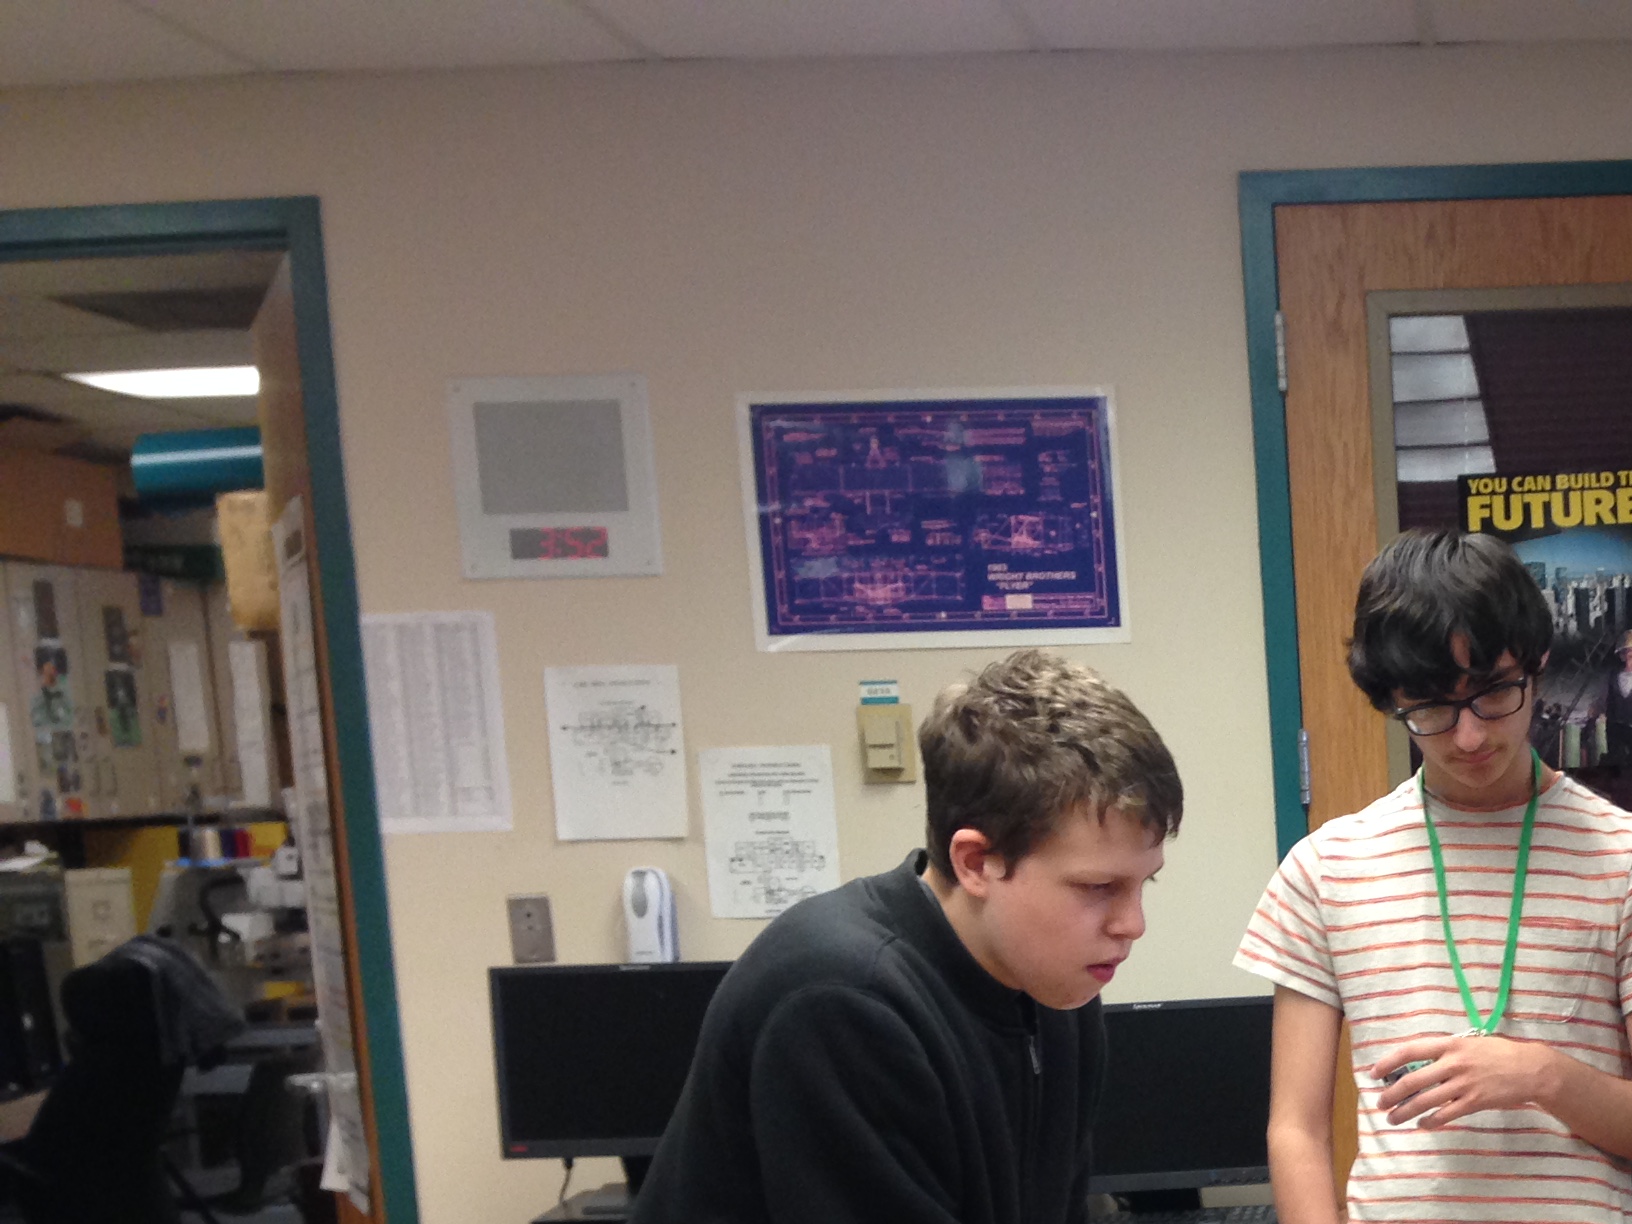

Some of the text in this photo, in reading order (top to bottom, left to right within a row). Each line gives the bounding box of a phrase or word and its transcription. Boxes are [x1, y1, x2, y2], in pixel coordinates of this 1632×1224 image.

[1468, 477, 1507, 495] YOU
[1511, 474, 1551, 492] CAN
[1556, 471, 1615, 489] BUILD
